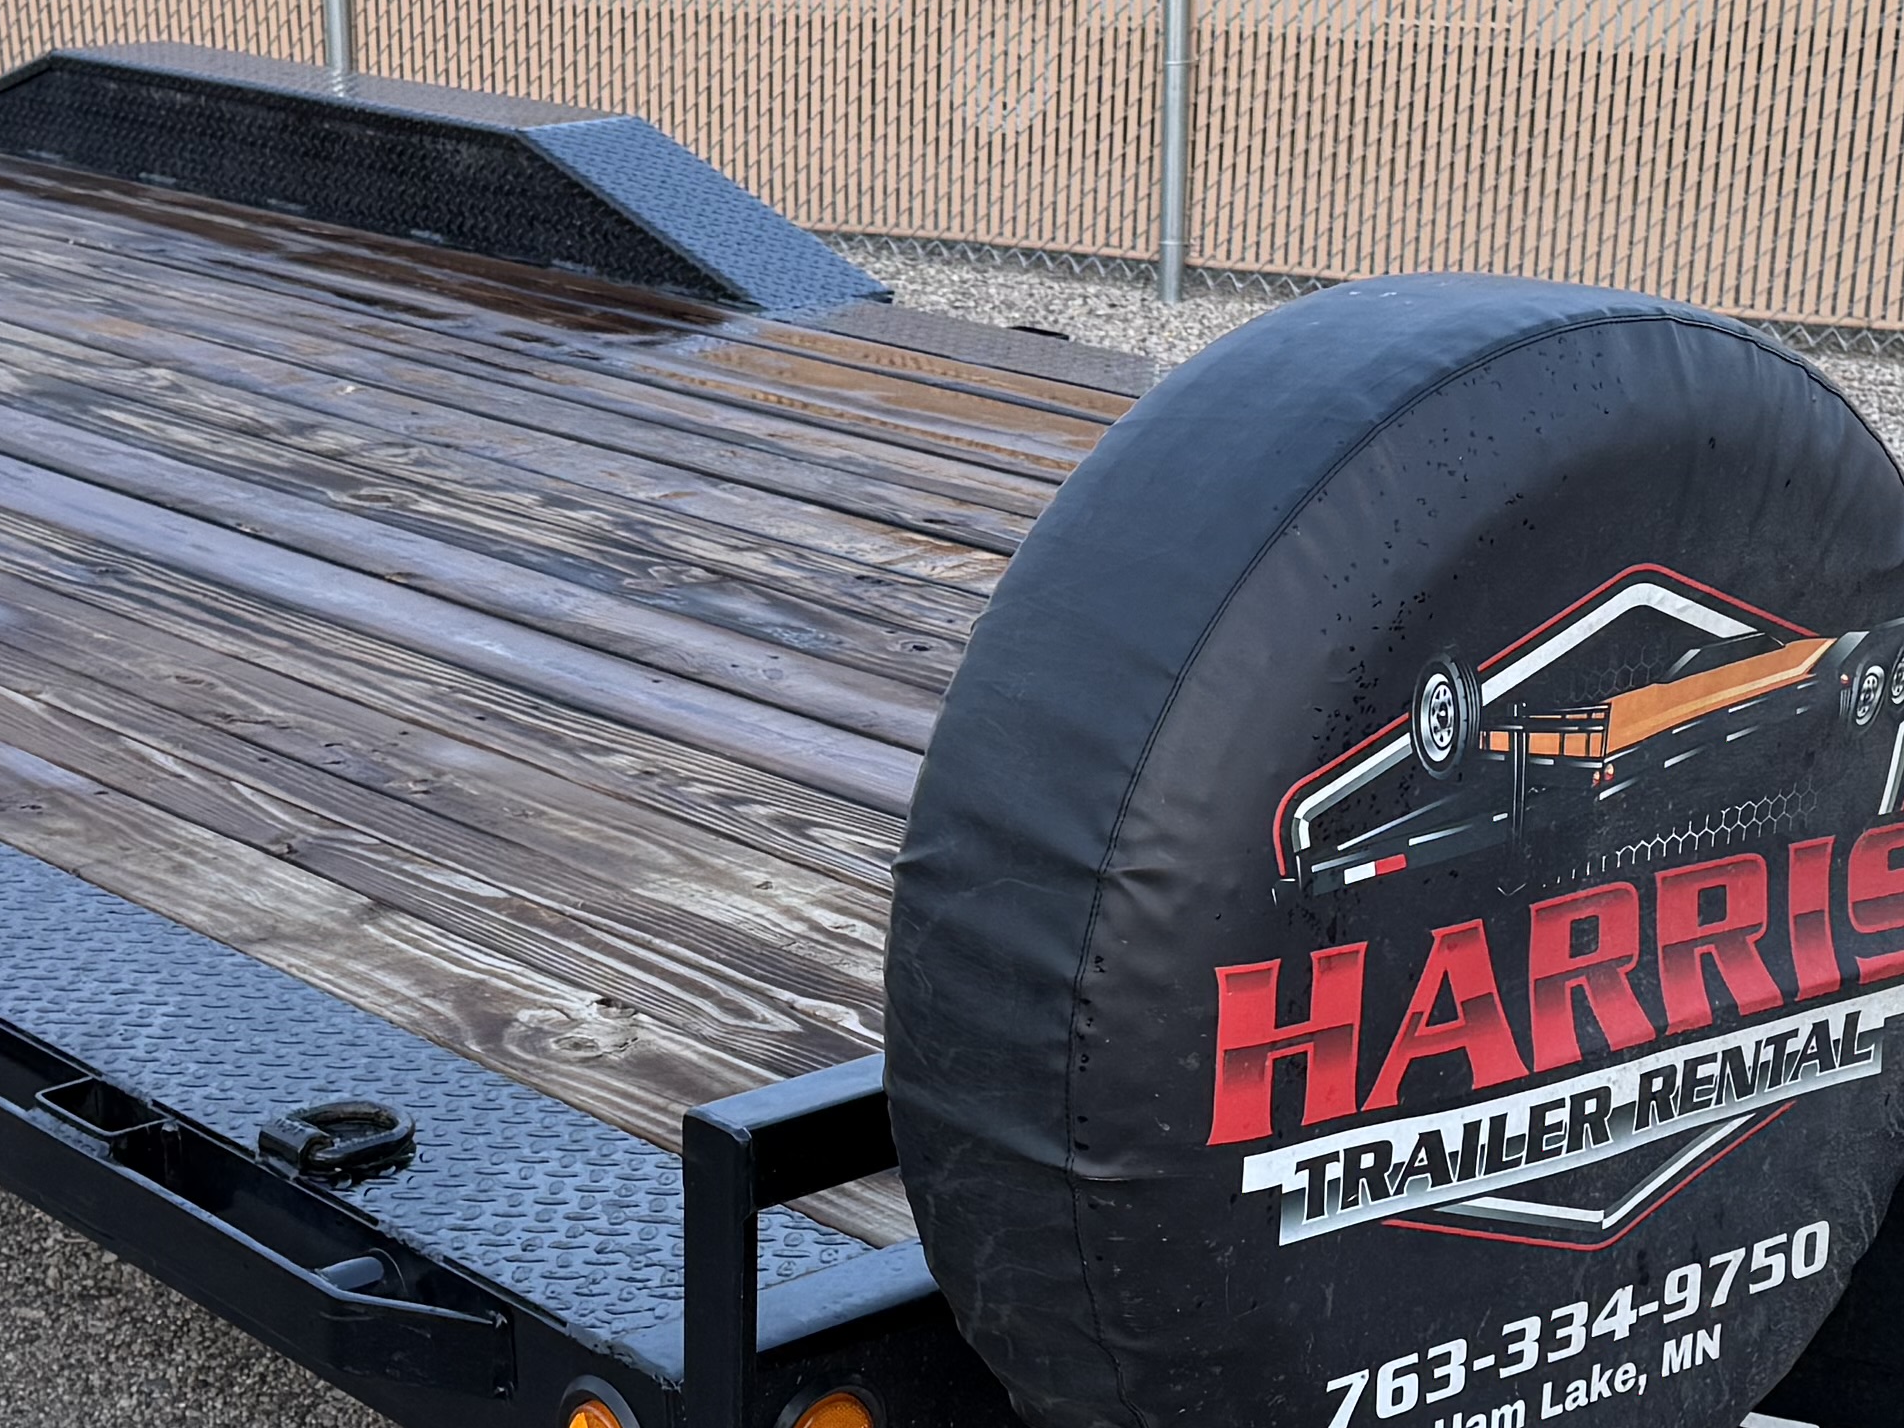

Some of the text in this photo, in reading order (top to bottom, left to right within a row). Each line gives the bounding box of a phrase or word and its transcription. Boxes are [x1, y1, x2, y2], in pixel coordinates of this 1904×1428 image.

[1296, 1009, 1877, 1226] TRAILER RENTAL
[1540, 1359, 1649, 1422] Lake,
[1660, 1323, 1724, 1379] MN
